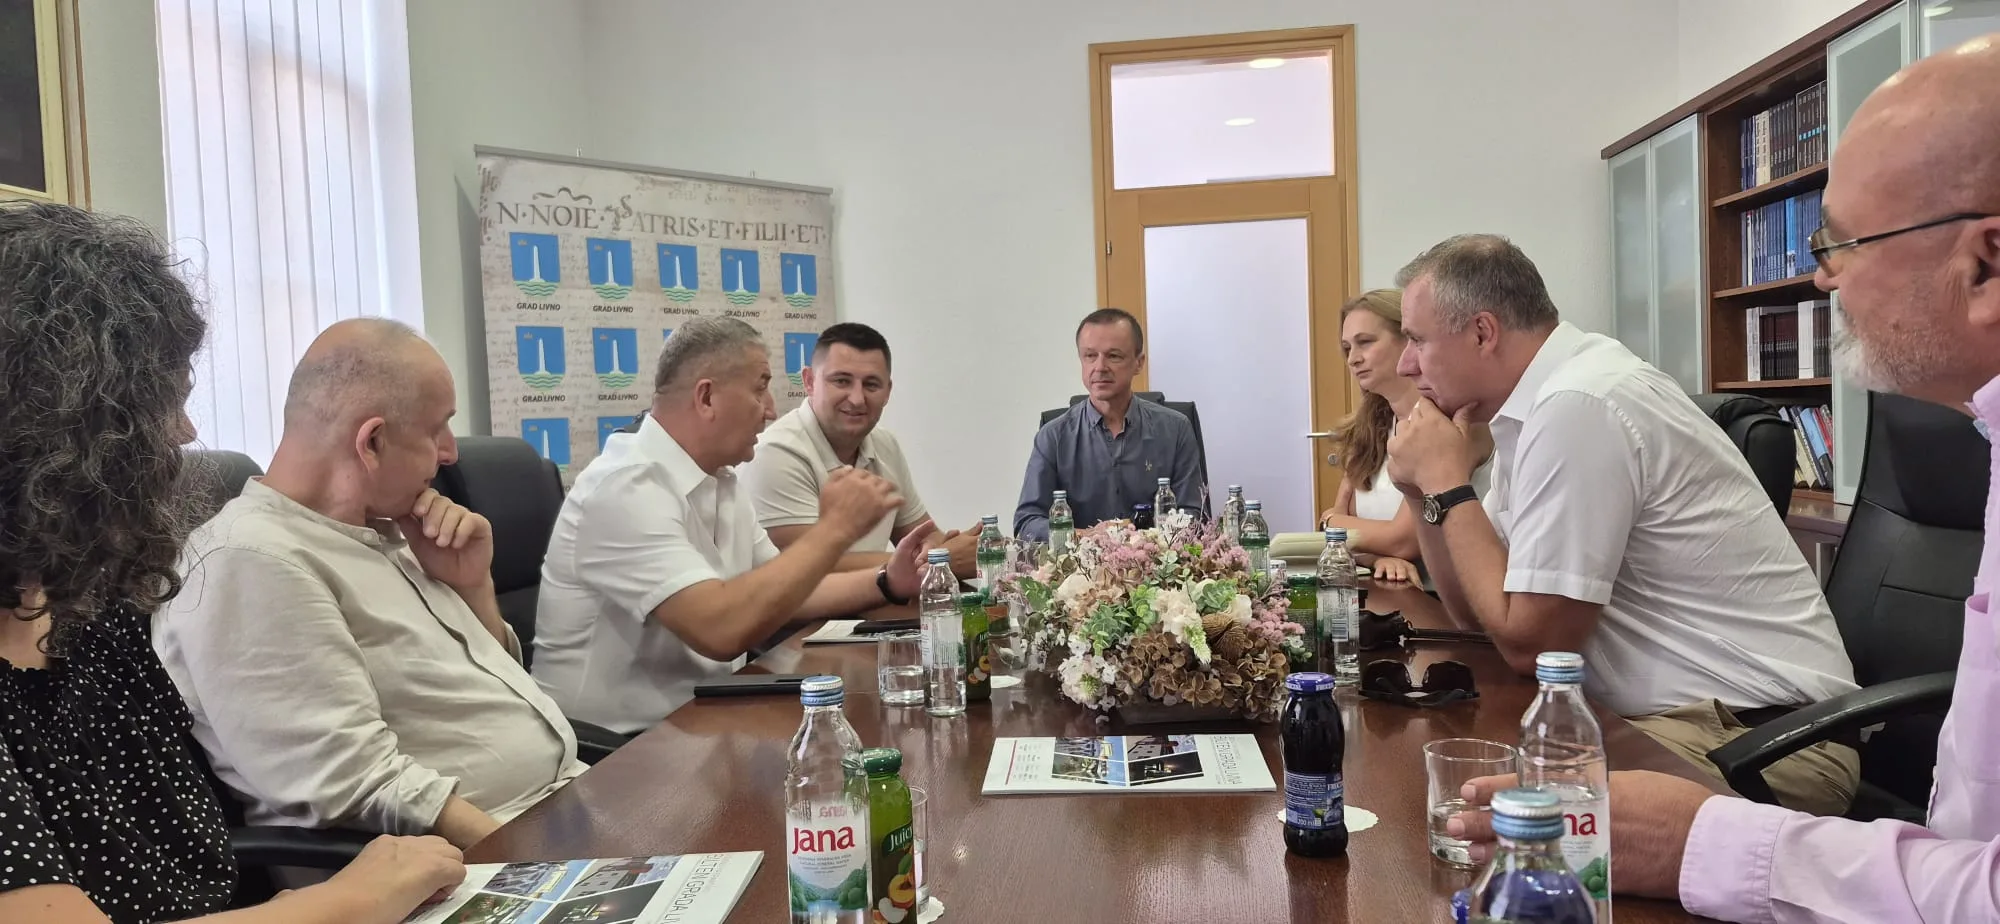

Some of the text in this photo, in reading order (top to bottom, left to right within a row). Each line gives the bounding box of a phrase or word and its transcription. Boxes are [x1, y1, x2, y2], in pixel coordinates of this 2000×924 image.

[516, 302, 561, 311] GRAD LIVNO
[663, 307, 699, 316] GRAD LIVNO
[543, 394, 566, 402] LIVNO
[1563, 812, 1598, 836] na
[791, 825, 856, 855] Jana
[668, 880, 705, 913] GRADA
